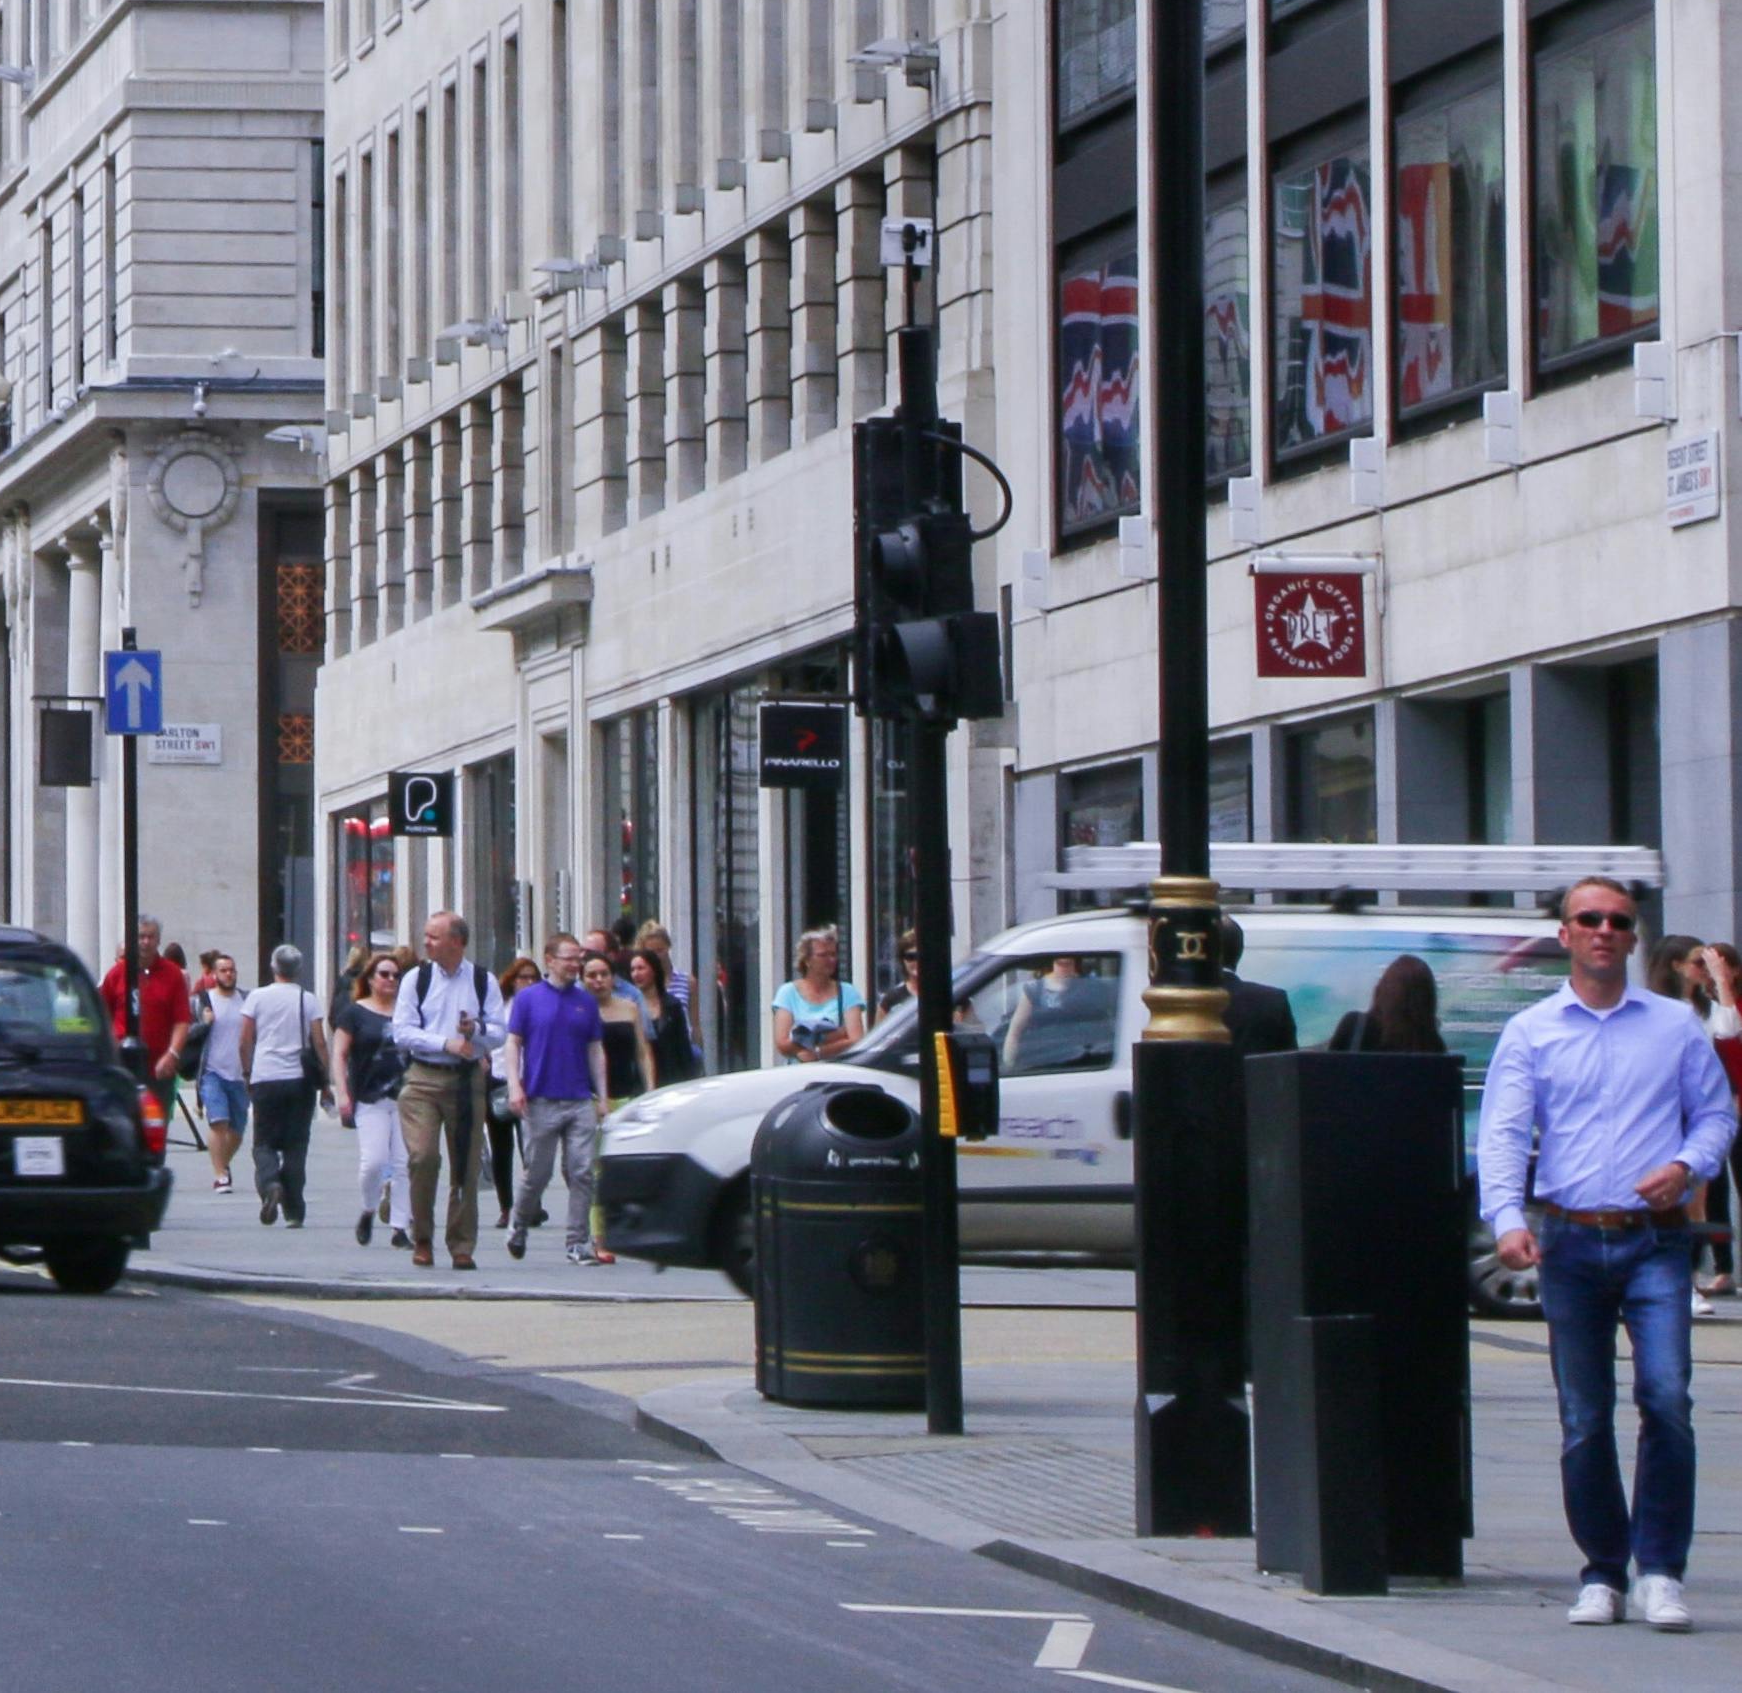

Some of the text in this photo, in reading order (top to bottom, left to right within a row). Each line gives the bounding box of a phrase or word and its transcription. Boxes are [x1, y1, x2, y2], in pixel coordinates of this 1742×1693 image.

[1265, 579, 1356, 621] ORGANIC COFFEE
[1286, 609, 1335, 642] PRET
[1269, 636, 1354, 670] NATURAL FOOD
[155, 739, 191, 750] STREET
[764, 758, 840, 769] PINARELLO
